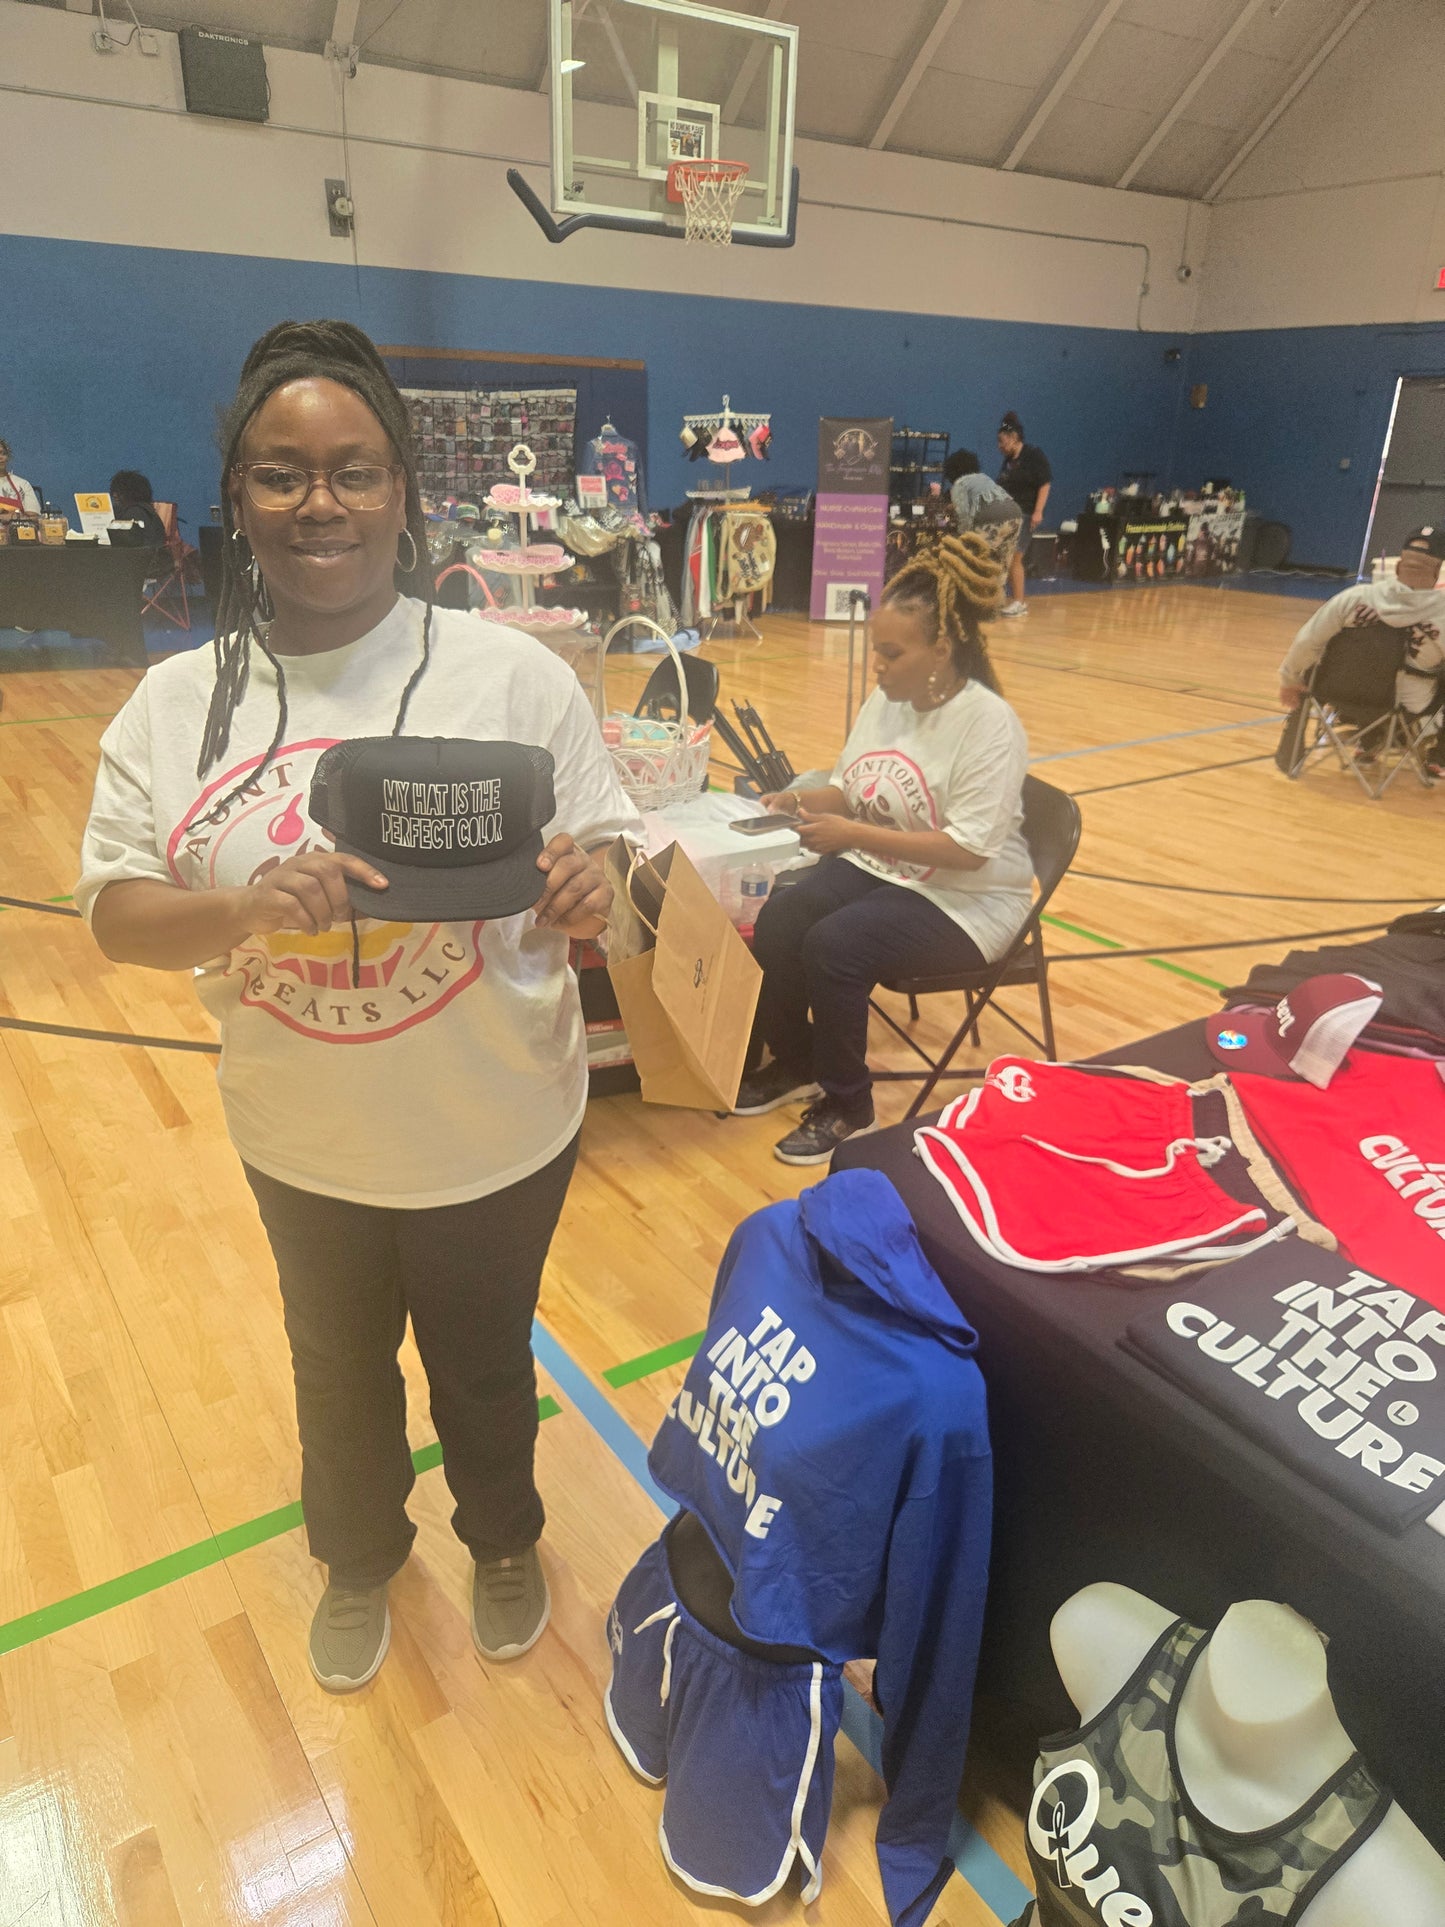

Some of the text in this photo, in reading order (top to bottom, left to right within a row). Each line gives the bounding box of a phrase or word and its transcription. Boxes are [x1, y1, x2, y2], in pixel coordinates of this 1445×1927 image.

[198, 31, 248, 45] DAKTRONICS
[381, 812, 503, 850] PERFECT COLOR
[383, 778, 501, 815] MY HAT IS THE
[400, 942, 466, 1004] LLC
[748, 1305, 816, 1383] TAP
[1273, 1280, 1437, 1382] INTO
[1335, 1270, 1445, 1345] TAP
[706, 1326, 791, 1427] INTO
[1166, 1302, 1445, 1493] CULTURE
[1268, 1308, 1394, 1412] THE
[709, 1369, 759, 1460] THE
[1028, 1760, 1153, 1927] Que
